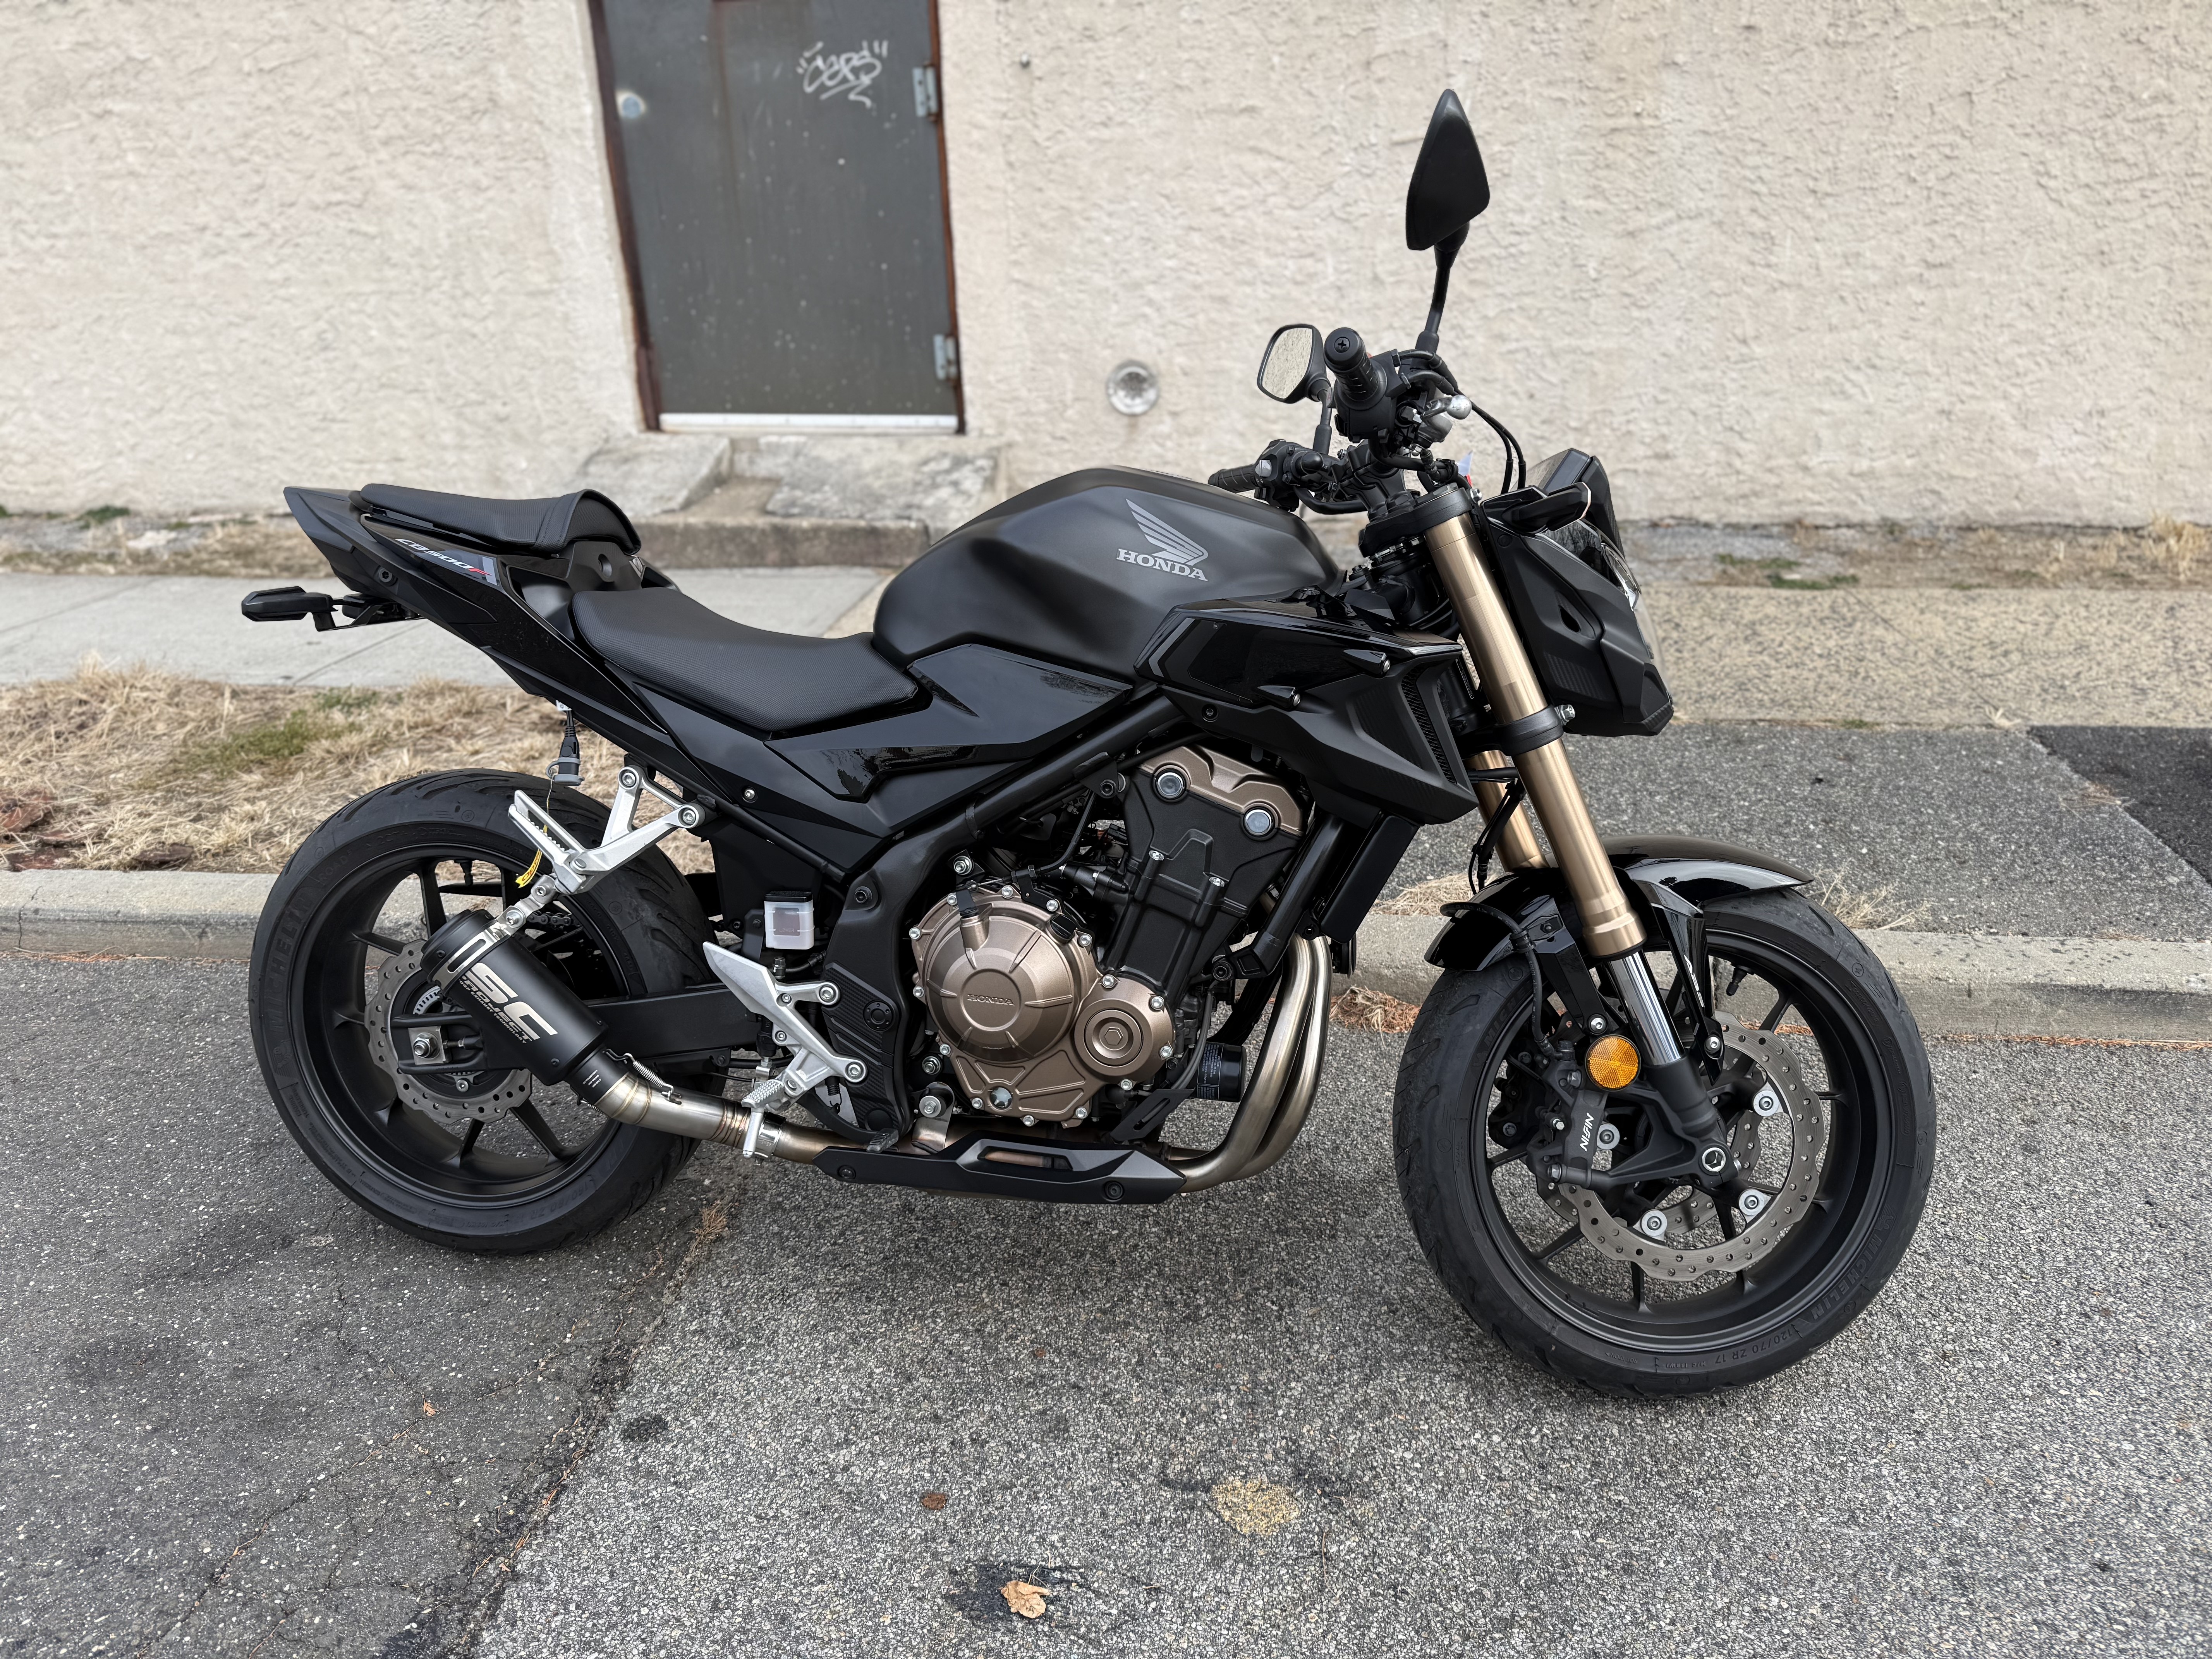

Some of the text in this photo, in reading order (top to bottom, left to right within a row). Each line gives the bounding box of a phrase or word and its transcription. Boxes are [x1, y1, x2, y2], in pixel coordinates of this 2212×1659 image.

[1116, 548, 1208, 582] HONDA
[268, 895, 312, 1033] MICHELIN
[465, 963, 558, 1040] SC
[967, 994, 1015, 1006] HONDA
[1580, 1112, 1594, 1152] NISSIN
[1812, 1234, 1883, 1321] MICHELIN
[1712, 1353, 1727, 1365] 17
[1730, 1346, 1750, 1362] ZR
[1751, 1329, 1794, 1355] 120/70
